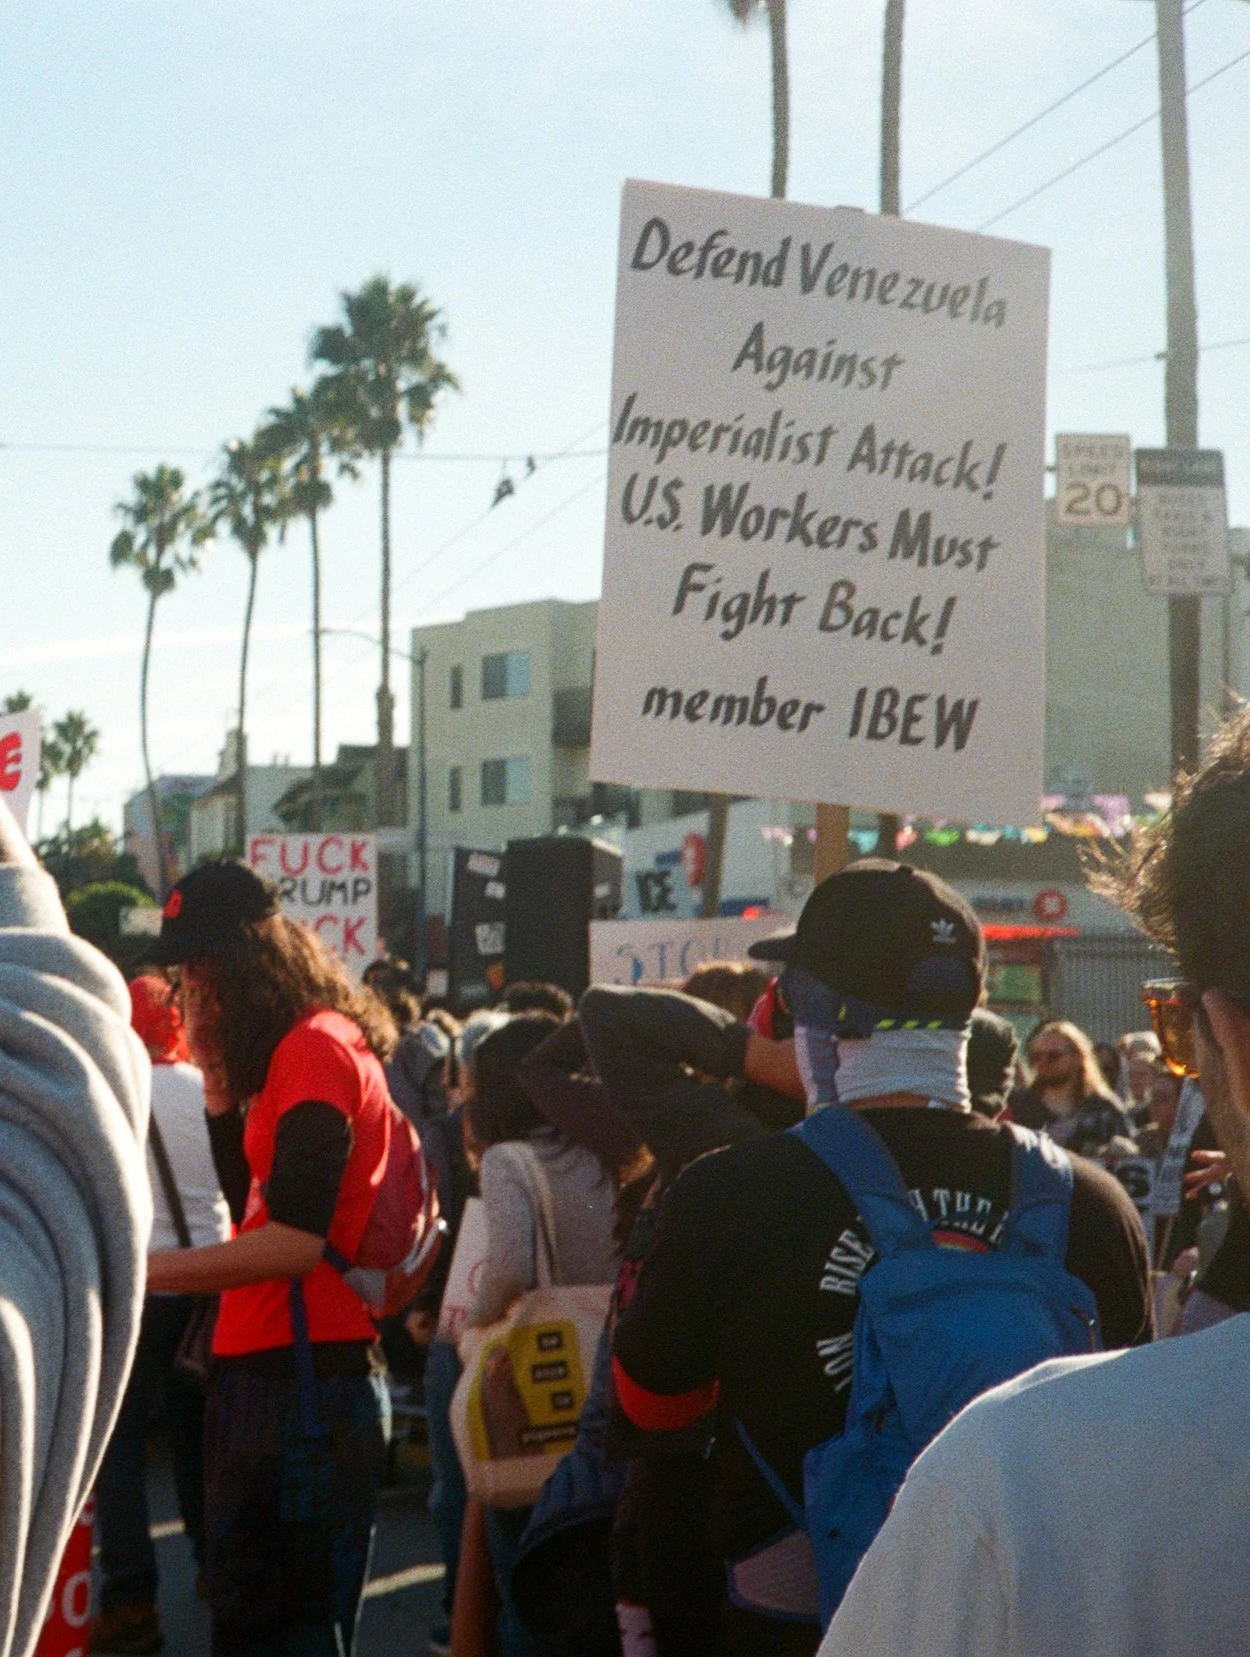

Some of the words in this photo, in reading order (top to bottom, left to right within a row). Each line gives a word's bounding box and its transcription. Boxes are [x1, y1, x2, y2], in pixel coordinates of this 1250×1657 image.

[630, 216, 793, 288] Defend
[800, 241, 1008, 328] Venezuela
[732, 321, 905, 392] Against
[612, 391, 840, 465] Imperialist
[847, 422, 1007, 501] Attack!
[620, 472, 685, 533] U.S.
[700, 481, 879, 554] Workers
[887, 507, 1001, 572] Must
[1064, 481, 1122, 517] 20
[671, 561, 808, 641] Fight
[818, 579, 957, 656] Back!
[641, 675, 826, 732] member
[848, 686, 980, 753] IBEW
[249, 834, 370, 878] FUCK
[279, 875, 373, 907] RUMP
[302, 913, 368, 957] CK
[818, 1229, 876, 1296] RISE
